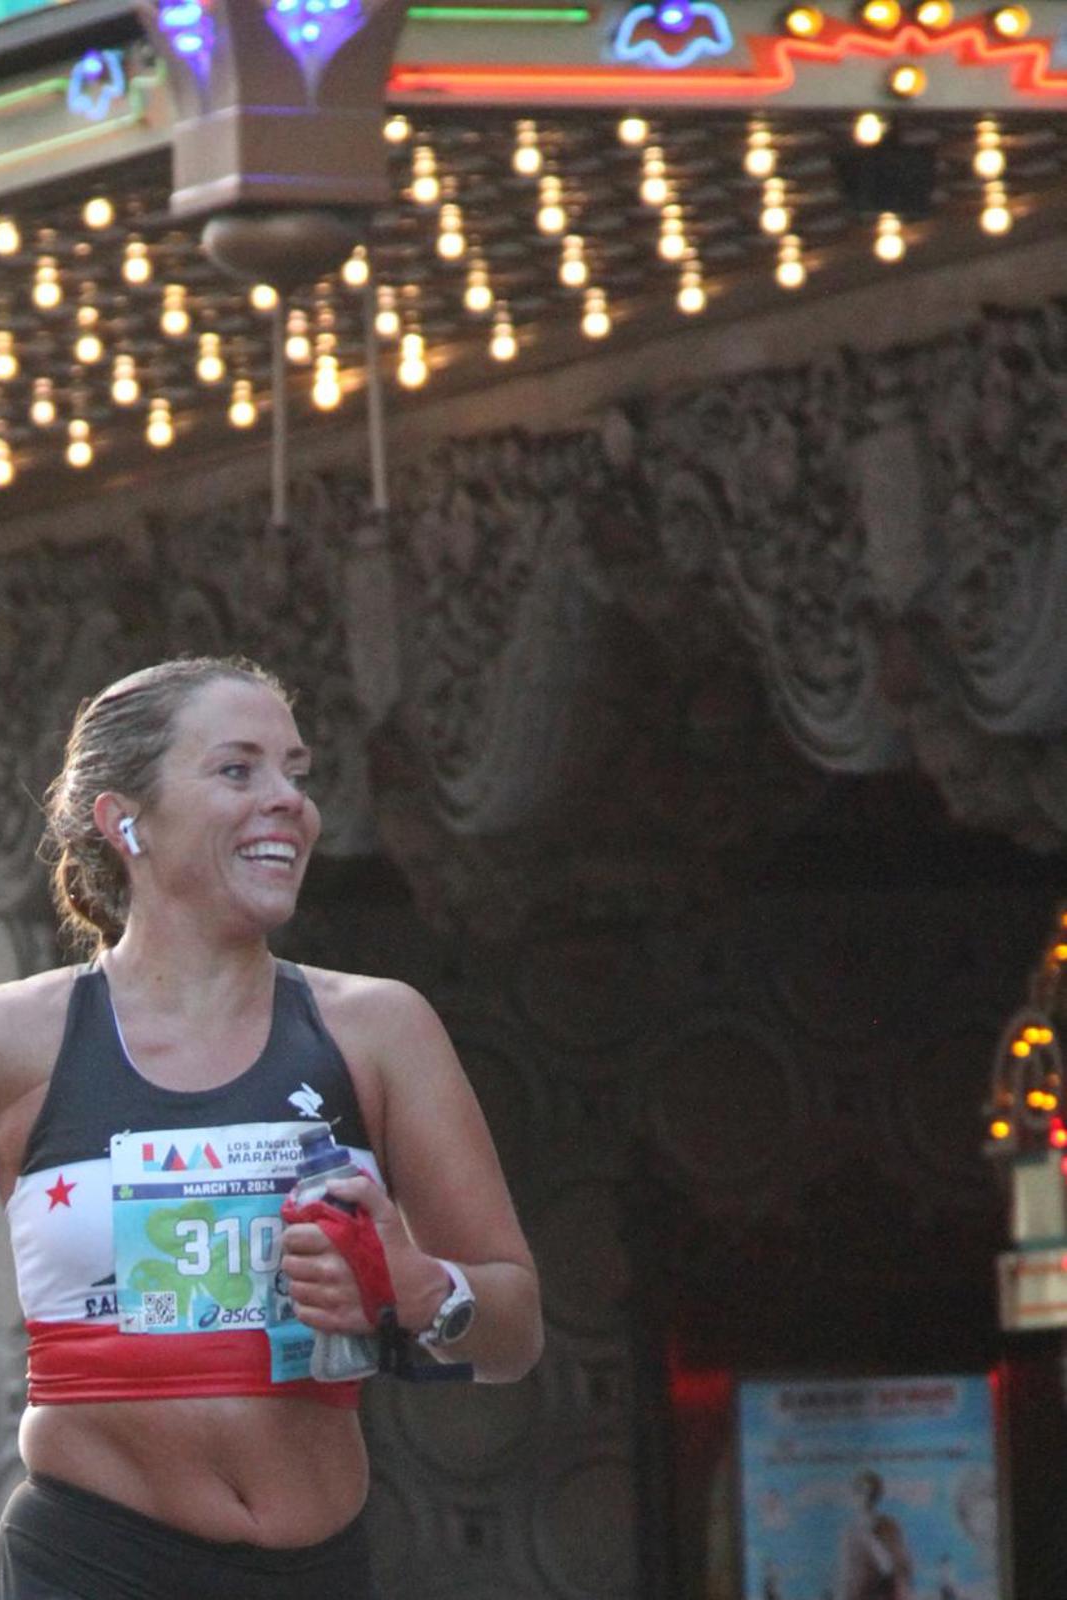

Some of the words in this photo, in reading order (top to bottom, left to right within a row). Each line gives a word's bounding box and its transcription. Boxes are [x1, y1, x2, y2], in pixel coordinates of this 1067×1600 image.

[227, 1141, 250, 1152] LOS
[256, 1138, 300, 1150] ANGELE
[182, 1182, 228, 1196] MARCH
[229, 1181, 246, 1194] 17,
[247, 1180, 276, 1193] 2024
